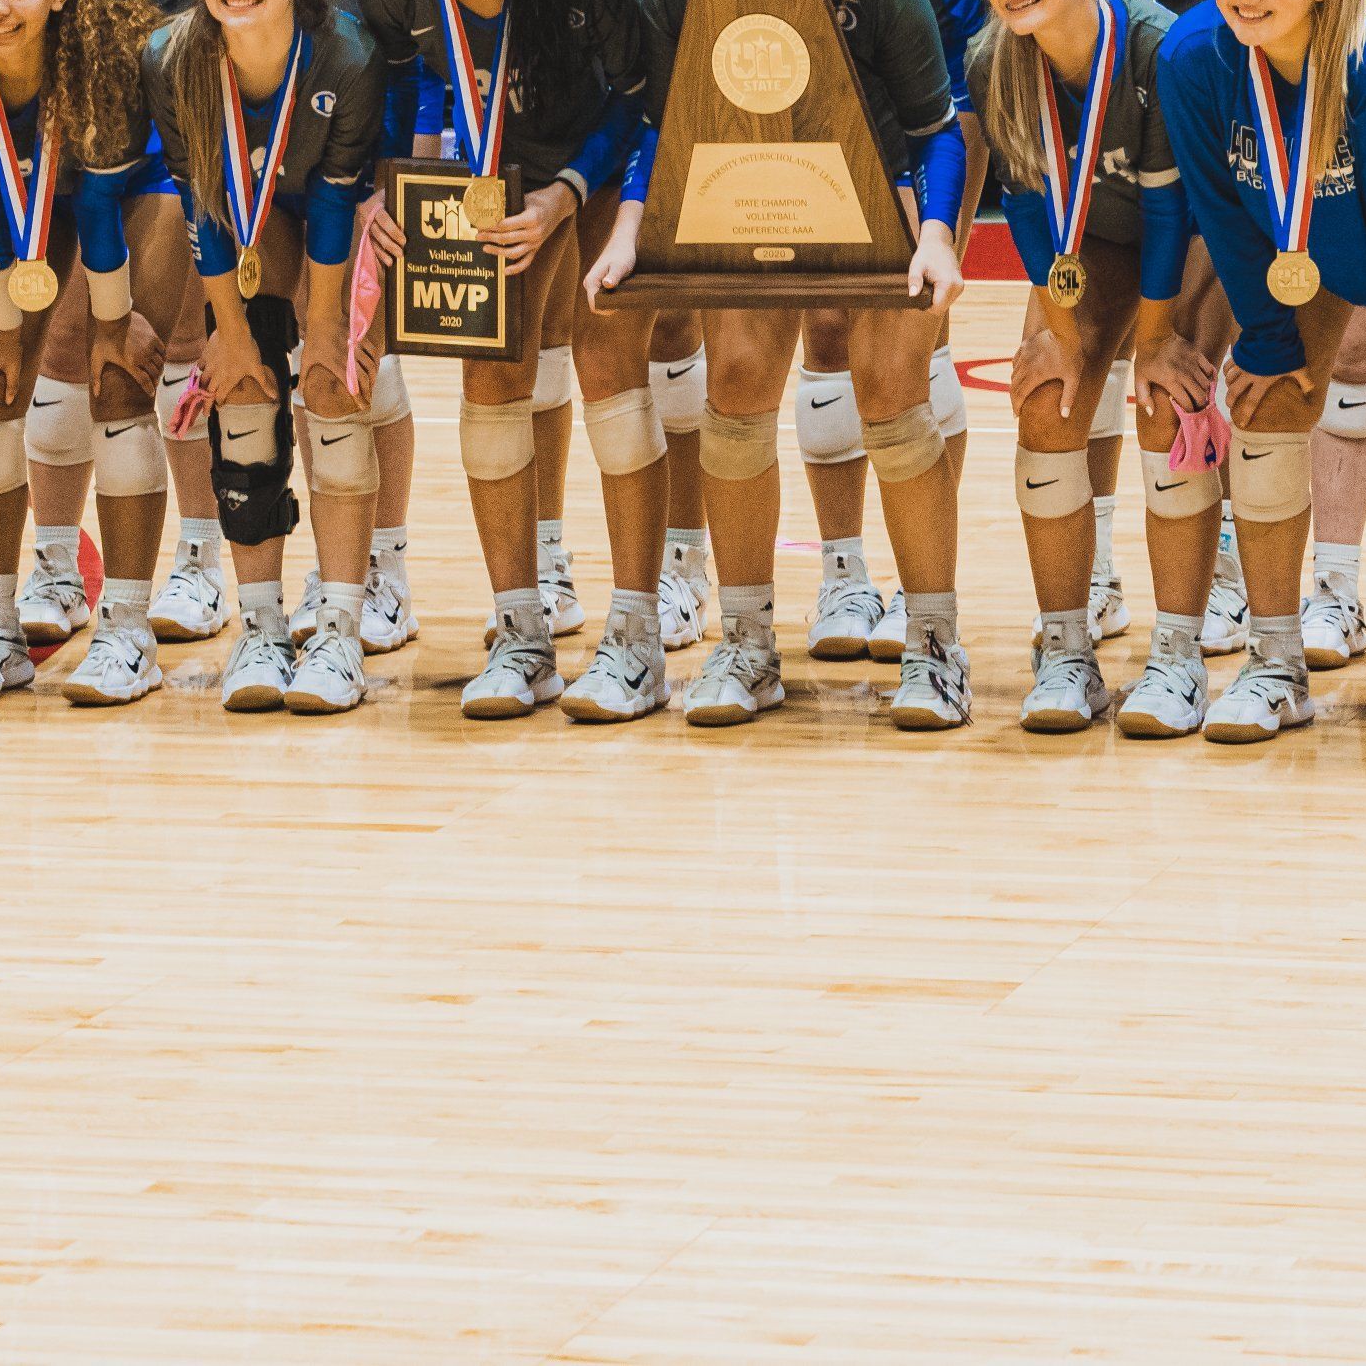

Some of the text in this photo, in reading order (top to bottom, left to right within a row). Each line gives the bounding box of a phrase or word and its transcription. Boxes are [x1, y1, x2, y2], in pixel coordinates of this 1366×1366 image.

[730, 35, 792, 80] UIL
[743, 81, 781, 92] STATE
[698, 152, 848, 202] UNIVERSITY INTERSCHOLASTIC LEAGUE
[1236, 170, 1268, 191] BAC
[735, 199, 808, 208] STATE CHAMPION
[421, 194, 479, 241] UIL
[746, 212, 798, 221] VOLLEYBALL
[732, 226, 814, 234] CONFERENCE AAAA
[429, 249, 473, 264] Volleyball
[763, 249, 786, 258] 2020
[407, 263, 495, 280] State Championships
[1057, 267, 1080, 289] UIL
[413, 281, 489, 311] MVP
[439, 316, 462, 327] 2020
